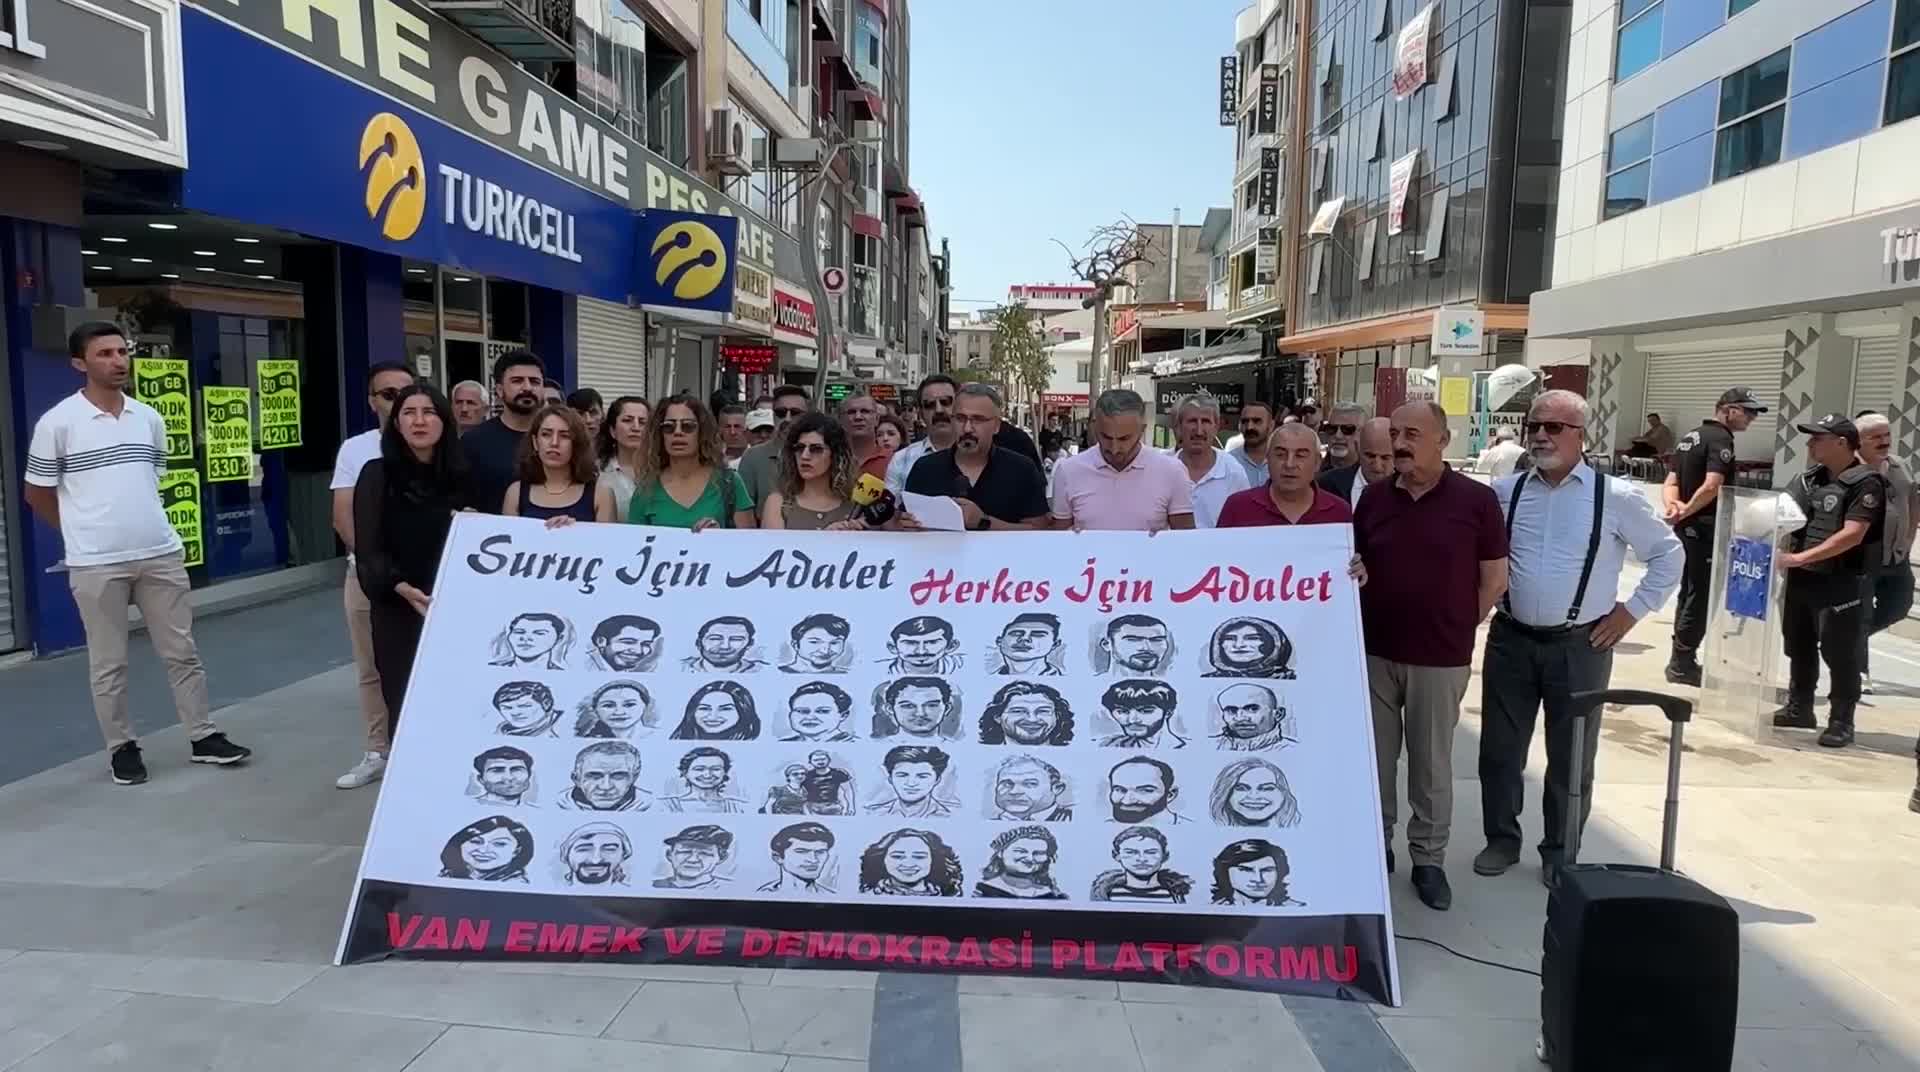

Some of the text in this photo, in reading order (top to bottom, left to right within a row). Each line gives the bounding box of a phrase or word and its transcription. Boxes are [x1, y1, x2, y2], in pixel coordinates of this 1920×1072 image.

[1223, 58, 1235, 110] SANAT
[1264, 86, 1274, 120] OKEY
[1221, 111, 1236, 123] 65
[226, 0, 437, 104] HE
[458, 56, 631, 200] GAME
[718, 205, 775, 268] AFE
[438, 162, 583, 264] TURKCELL
[779, 301, 812, 332] vodafone
[141, 376, 183, 397] 10 GB
[262, 375, 294, 393] 30 GB
[169, 402, 187, 417] DK
[209, 403, 245, 423] 20 GB
[283, 396, 297, 410] DK
[233, 425, 249, 440] DK
[263, 426, 289, 444] 420
[210, 443, 228, 455] 250
[211, 458, 238, 477] 330
[174, 486, 193, 499] GB
[180, 509, 198, 524] DK
[466, 534, 897, 598] Suruç İçin Adalet
[1732, 558, 1763, 581] POLİS
[909, 557, 1333, 613] Herkes İçin Adalet
[385, 911, 1360, 984] VAN EMEK VE DEMOKRASİ PLATFORMU
